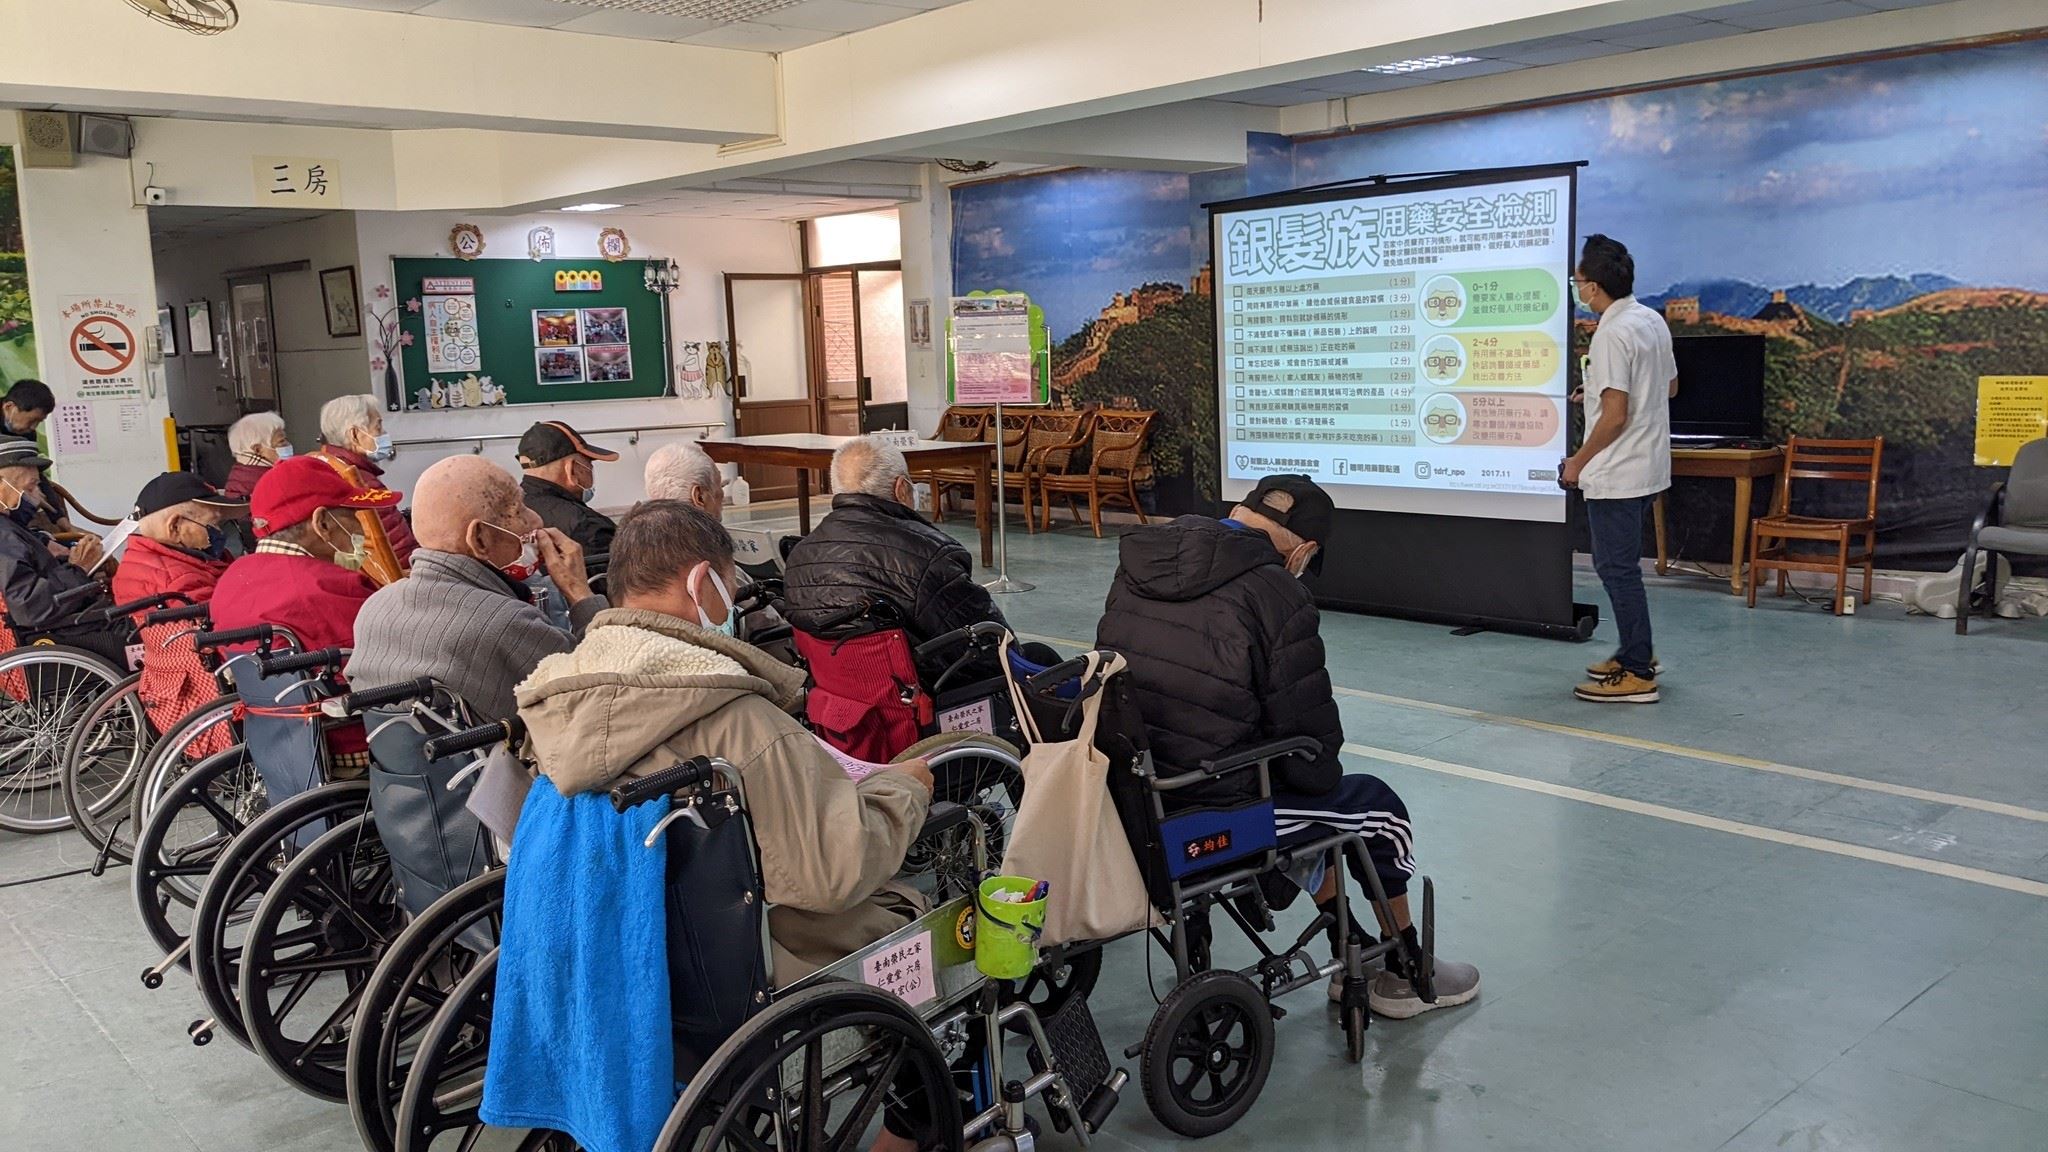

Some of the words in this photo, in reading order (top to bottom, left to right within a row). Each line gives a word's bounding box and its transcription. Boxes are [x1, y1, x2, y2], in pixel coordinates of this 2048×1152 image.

[271, 164, 328, 196] 三房
[460, 233, 475, 250] 公
[537, 235, 550, 251] 佈
[1228, 207, 1379, 276] 銀髮族
[1380, 191, 1556, 236] 用藥安全檢測
[62, 297, 136, 320] 本場所禁止吸菸
[90, 310, 117, 318] SMOKING
[1472, 397, 1505, 407] 5分以上
[1481, 469, 1510, 477] 2017.11
[873, 941, 922, 973] 臺南榮民之家
[877, 968, 902, 987] 仁愛堂
